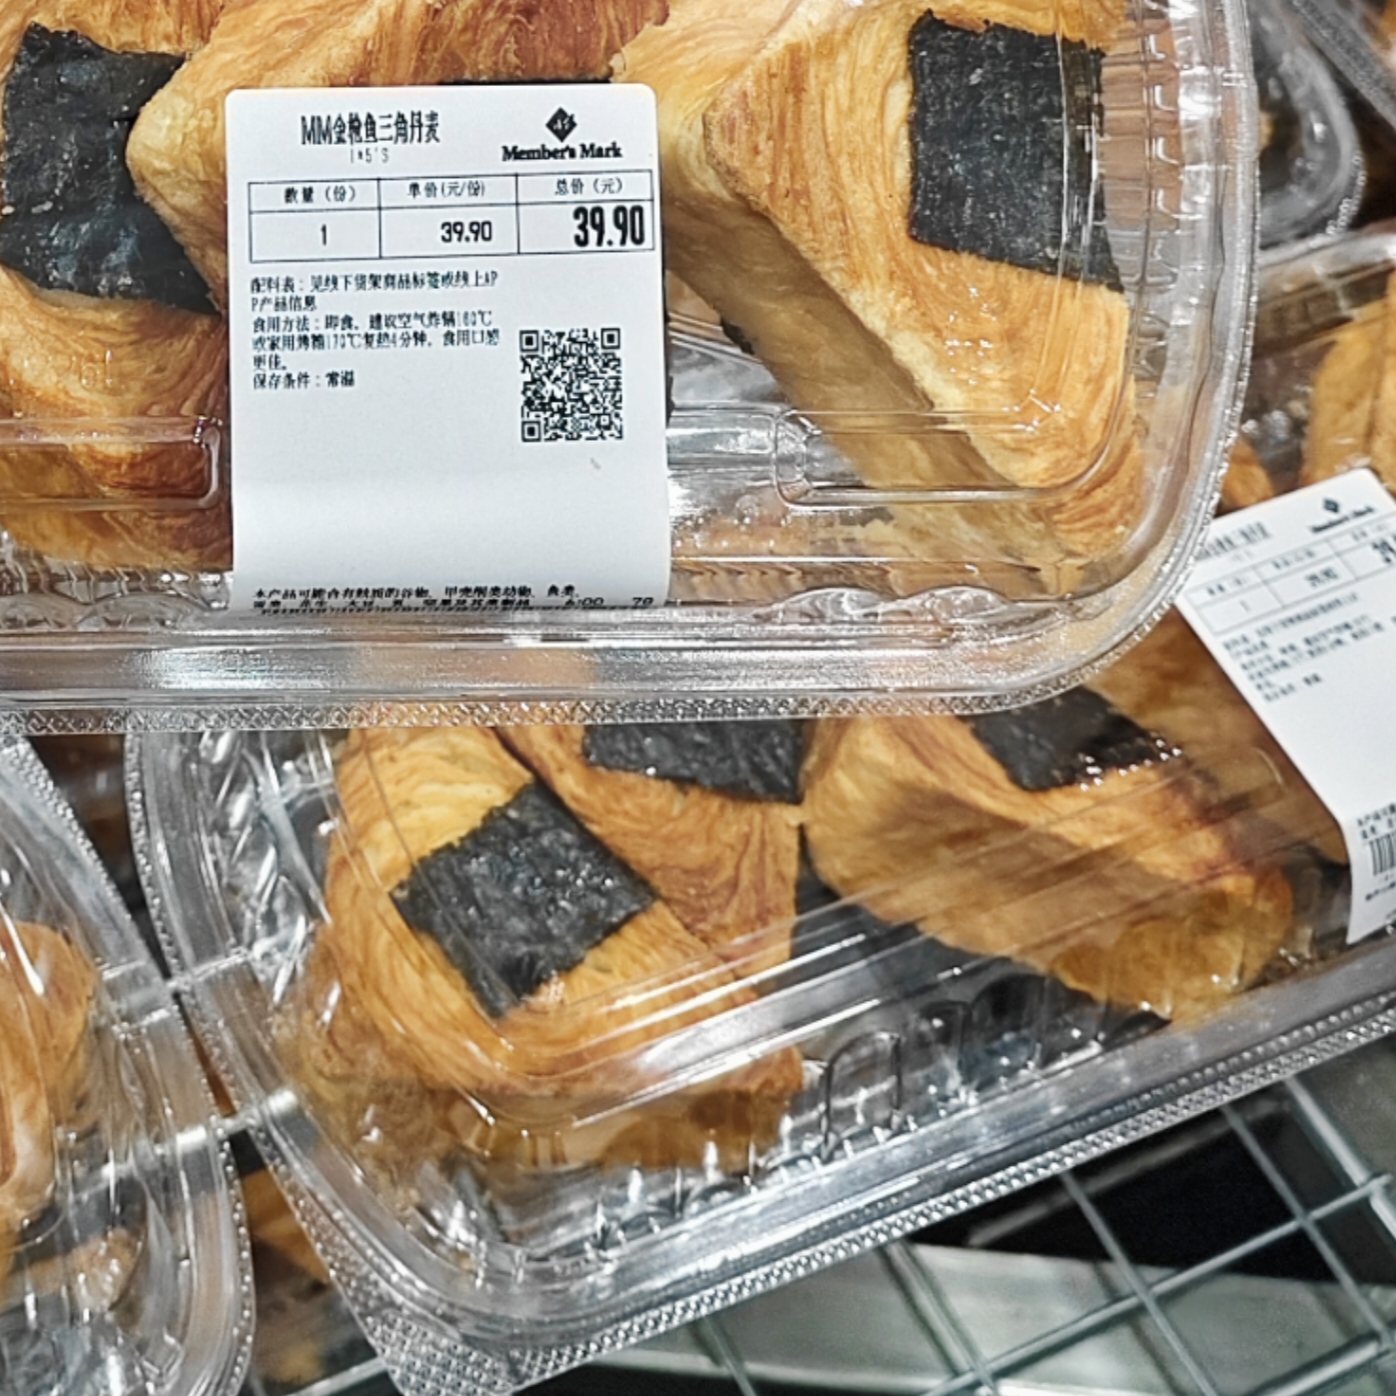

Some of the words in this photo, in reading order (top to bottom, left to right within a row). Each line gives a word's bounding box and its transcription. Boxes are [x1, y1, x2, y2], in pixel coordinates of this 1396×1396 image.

[300, 110, 441, 146] MM金枪鱼三角丹麦
[501, 143, 577, 162] Member's
[578, 140, 624, 159] Mark
[319, 225, 328, 247] 1
[440, 219, 493, 244] 39.90
[572, 204, 646, 248] 39.90
